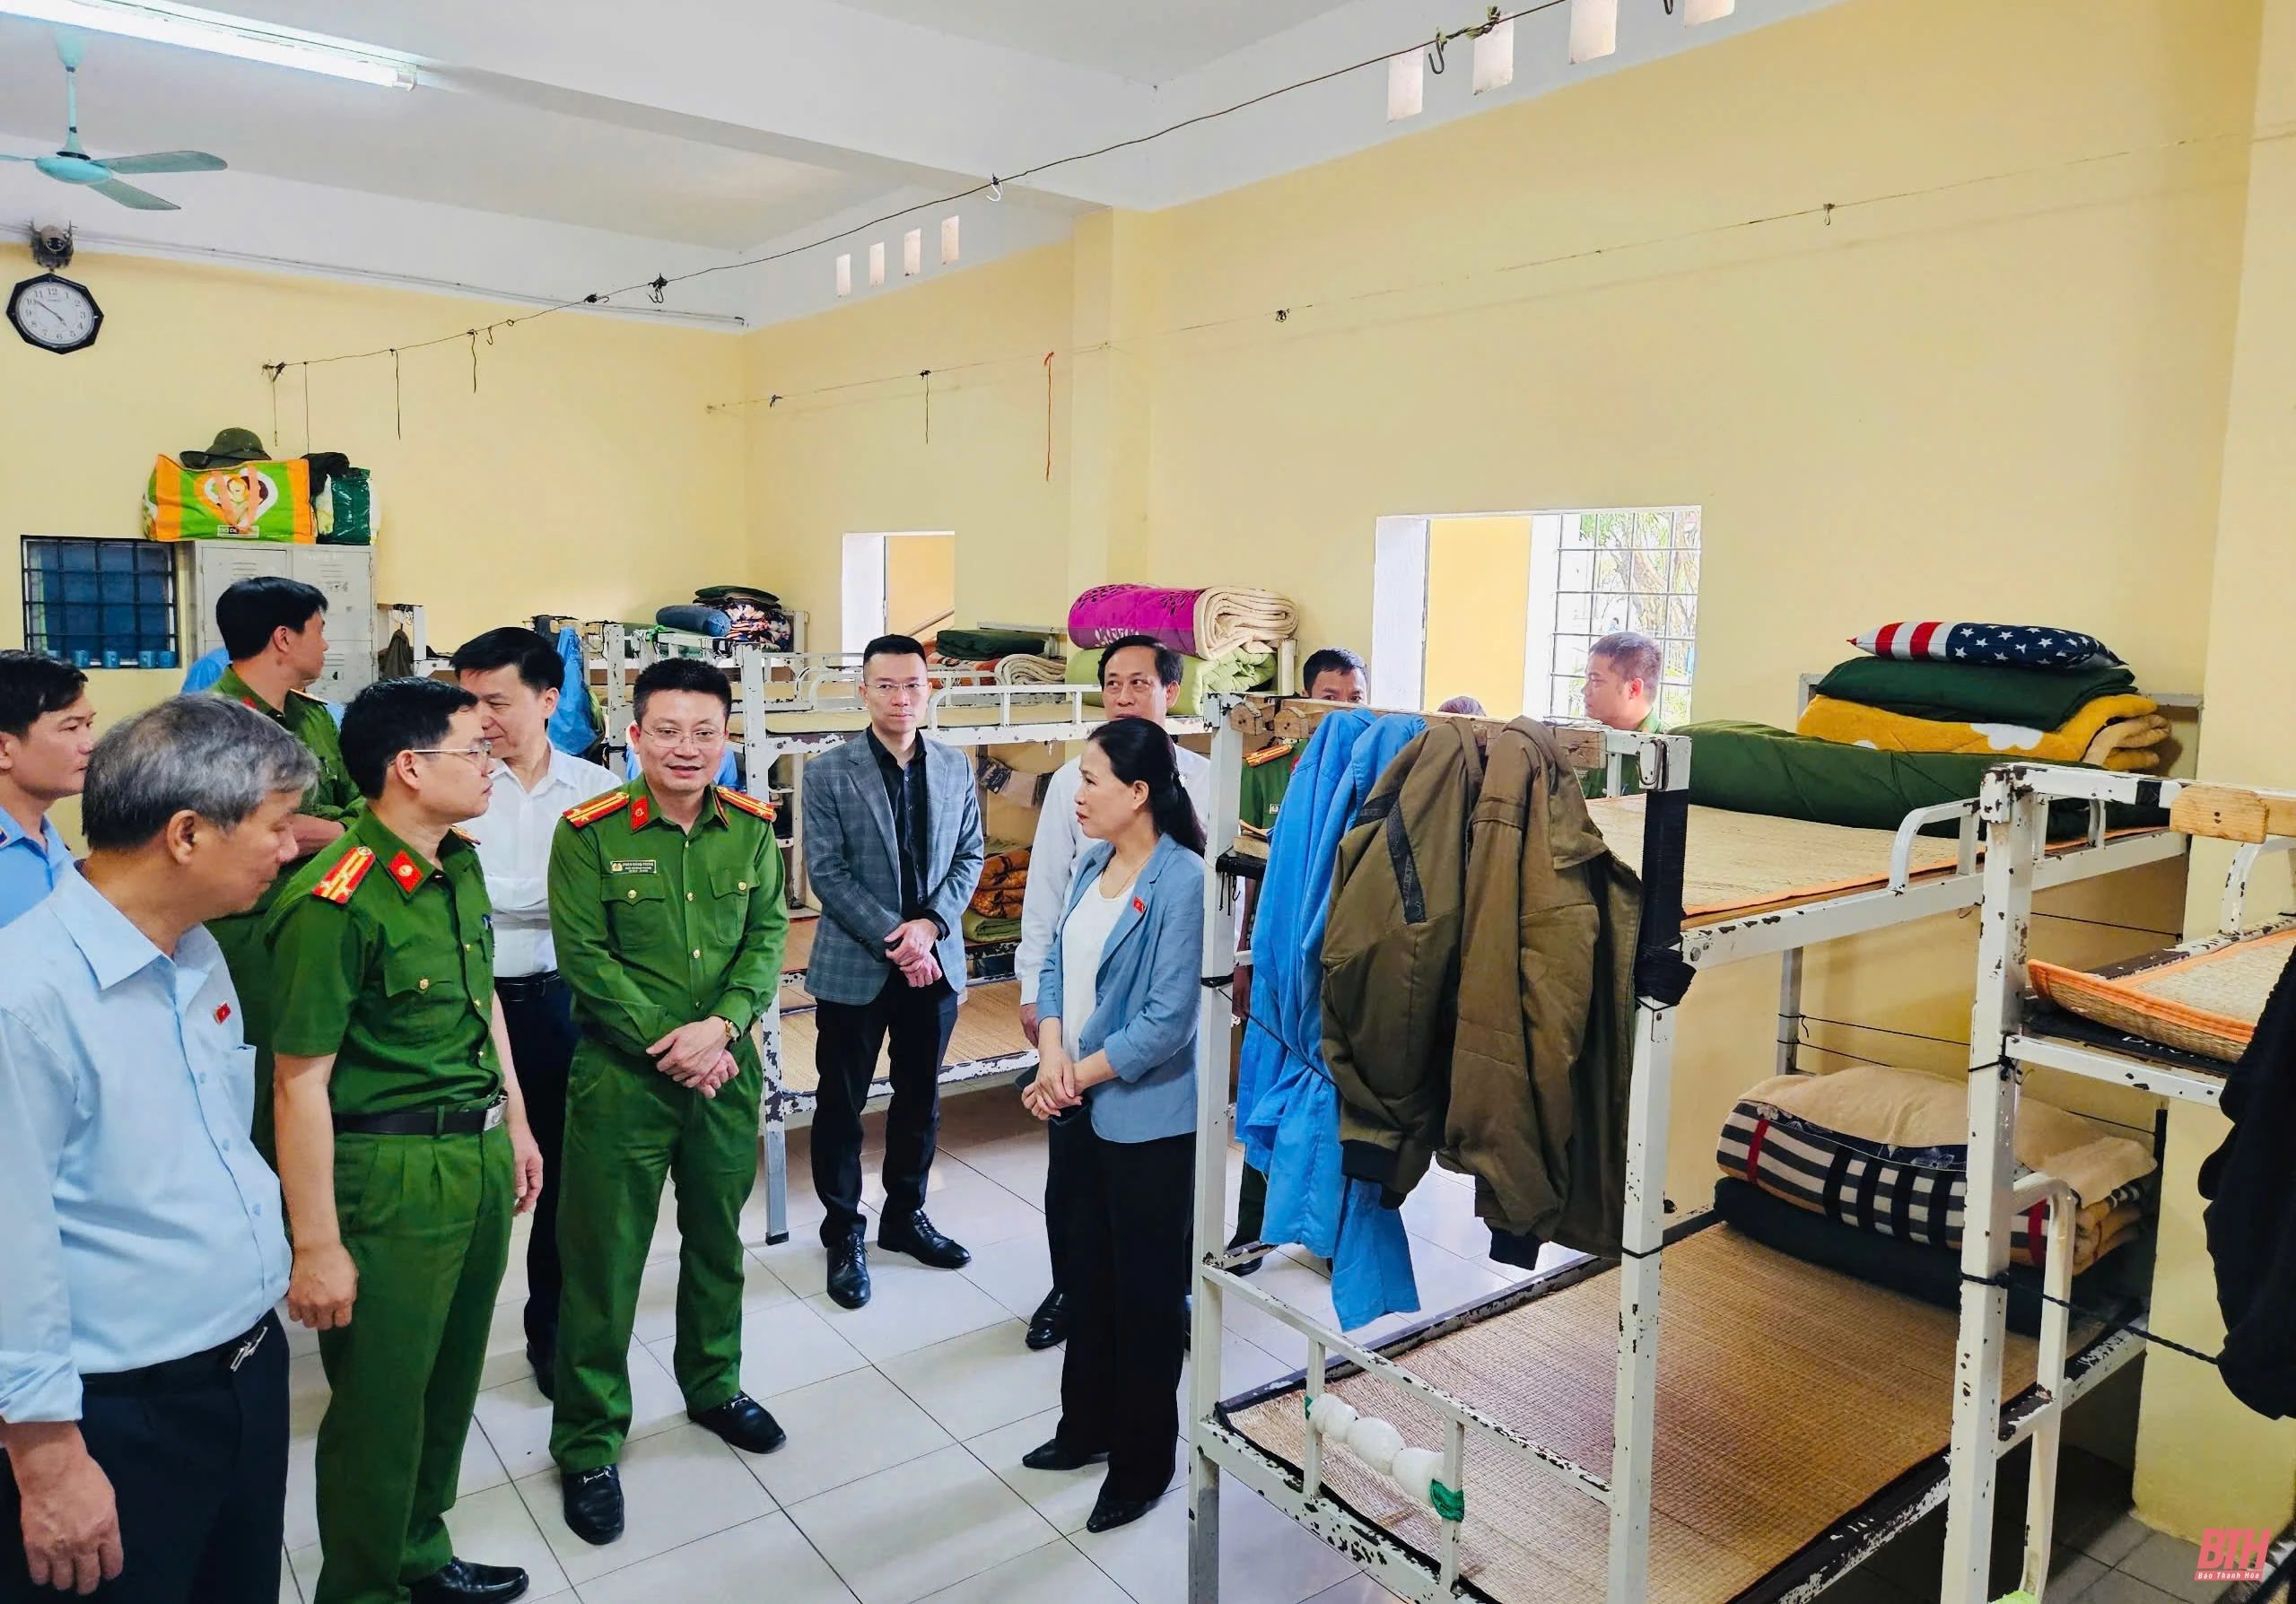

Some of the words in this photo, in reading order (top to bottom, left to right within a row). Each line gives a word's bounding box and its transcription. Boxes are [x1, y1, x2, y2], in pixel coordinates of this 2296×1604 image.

[35, 290, 43, 298] 11
[48, 287, 58, 295] 12
[80, 311, 86, 319] 3
[77, 322, 84, 330] 4
[70, 330, 76, 338] 5
